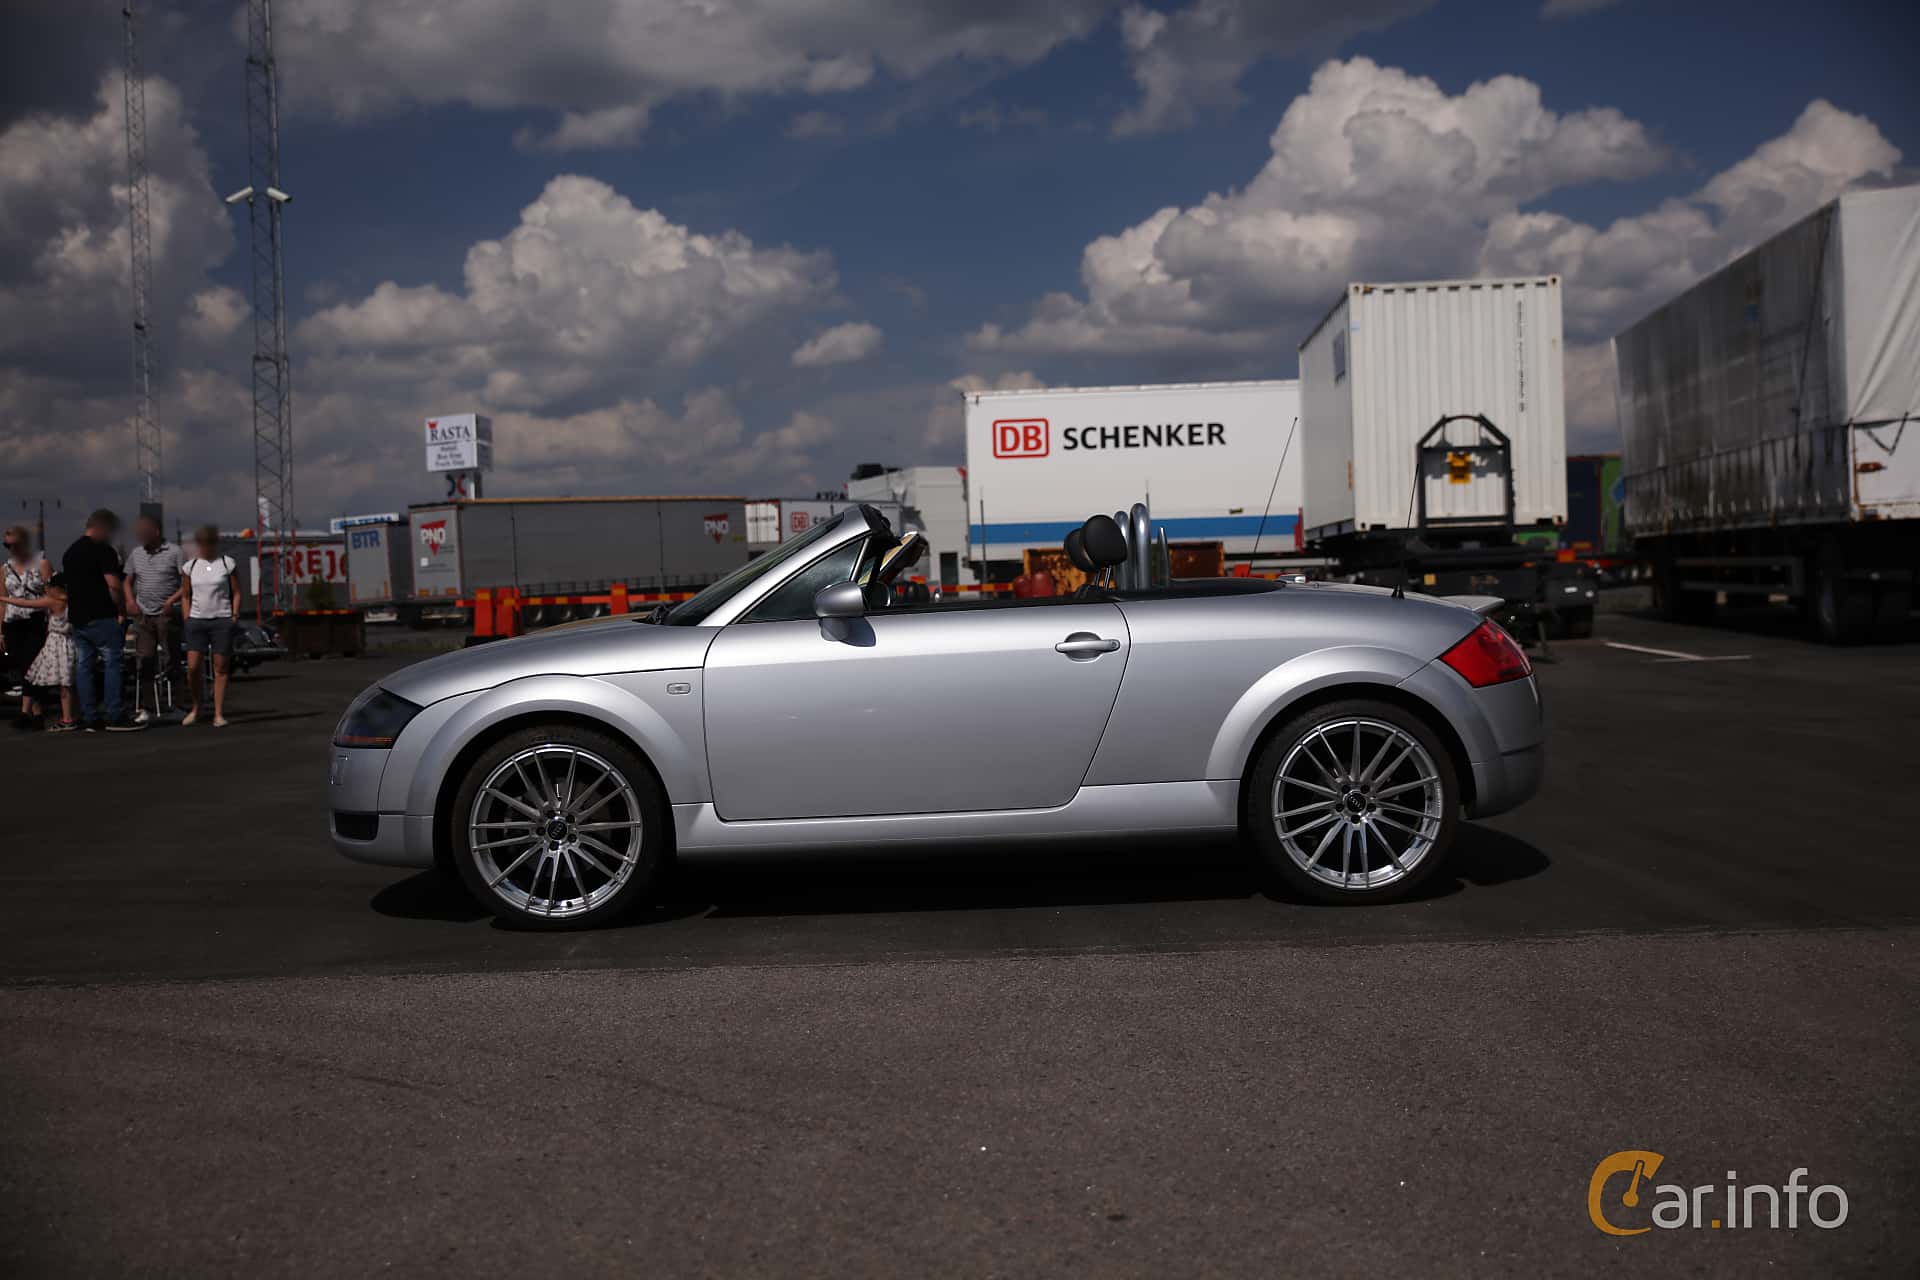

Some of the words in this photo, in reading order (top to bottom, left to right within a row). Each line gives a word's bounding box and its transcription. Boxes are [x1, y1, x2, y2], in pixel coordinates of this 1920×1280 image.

[430, 426, 470, 442] RASTA
[997, 422, 1045, 455] DB
[1063, 423, 1226, 450] SCHENKER
[419, 526, 446, 545] PNO
[704, 520, 729, 535] PNO
[352, 530, 380, 549] BTR
